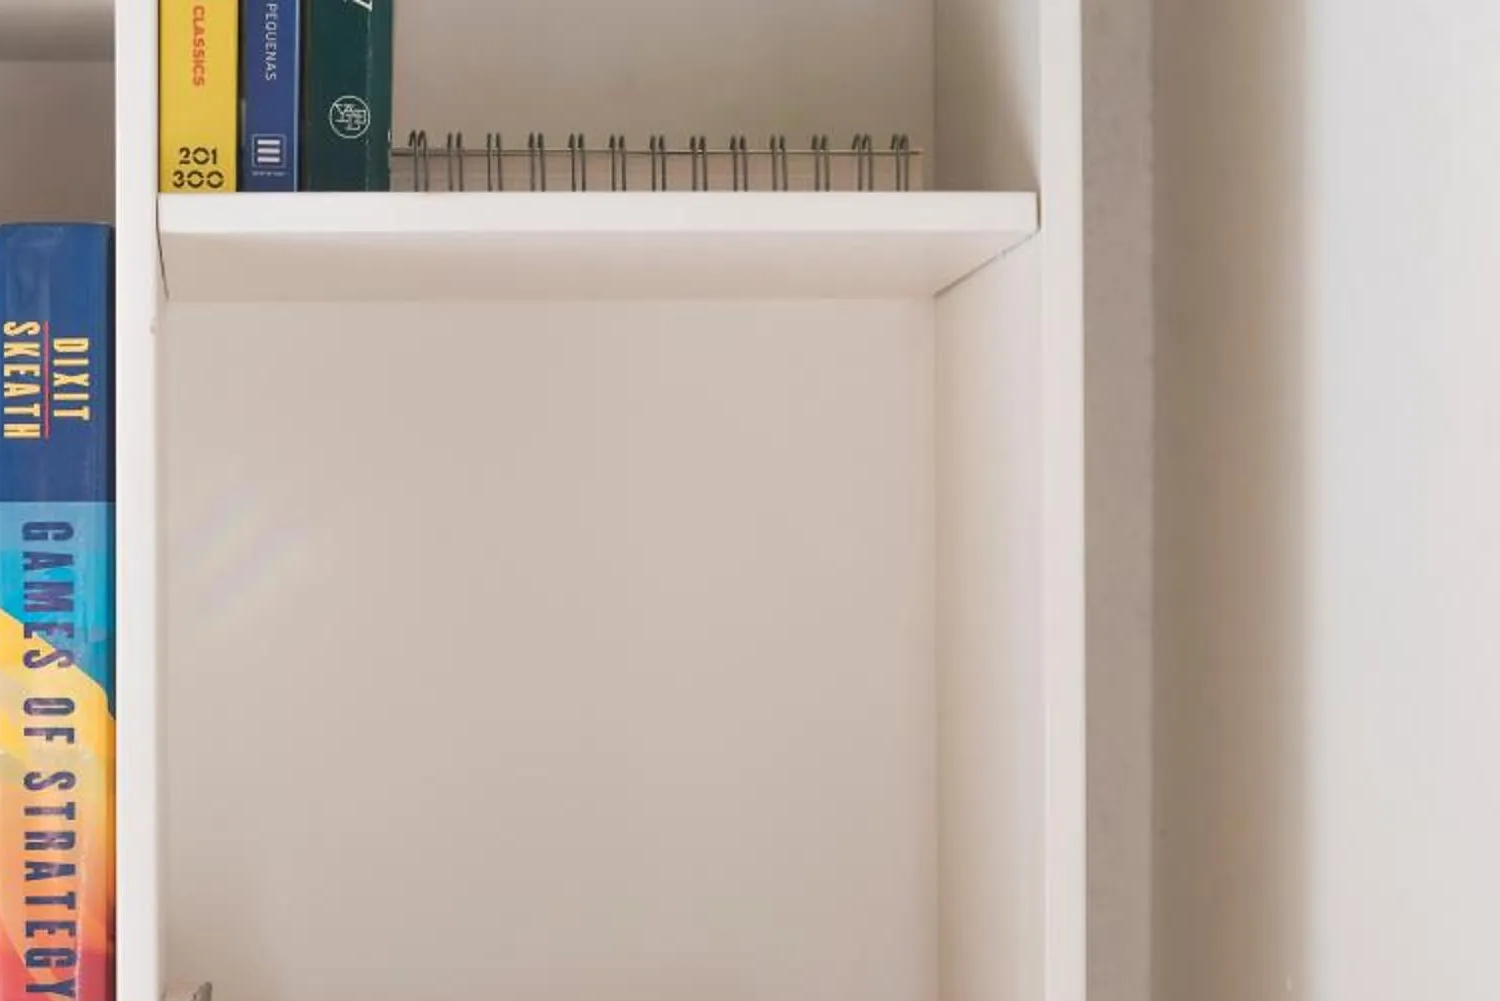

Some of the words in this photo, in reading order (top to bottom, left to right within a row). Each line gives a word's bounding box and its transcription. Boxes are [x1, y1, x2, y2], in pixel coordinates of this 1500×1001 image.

[192, 5, 206, 87] CLASSICS
[265, 2, 277, 82] PEQUENAS
[172, 169, 224, 189] 300
[179, 146, 218, 165] 201
[3, 321, 41, 439] SKEATH
[53, 337, 90, 421] DIXIT
[22, 521, 76, 672] GAMES
[23, 698, 76, 746] OF
[22, 772, 77, 999] STRATEGY
